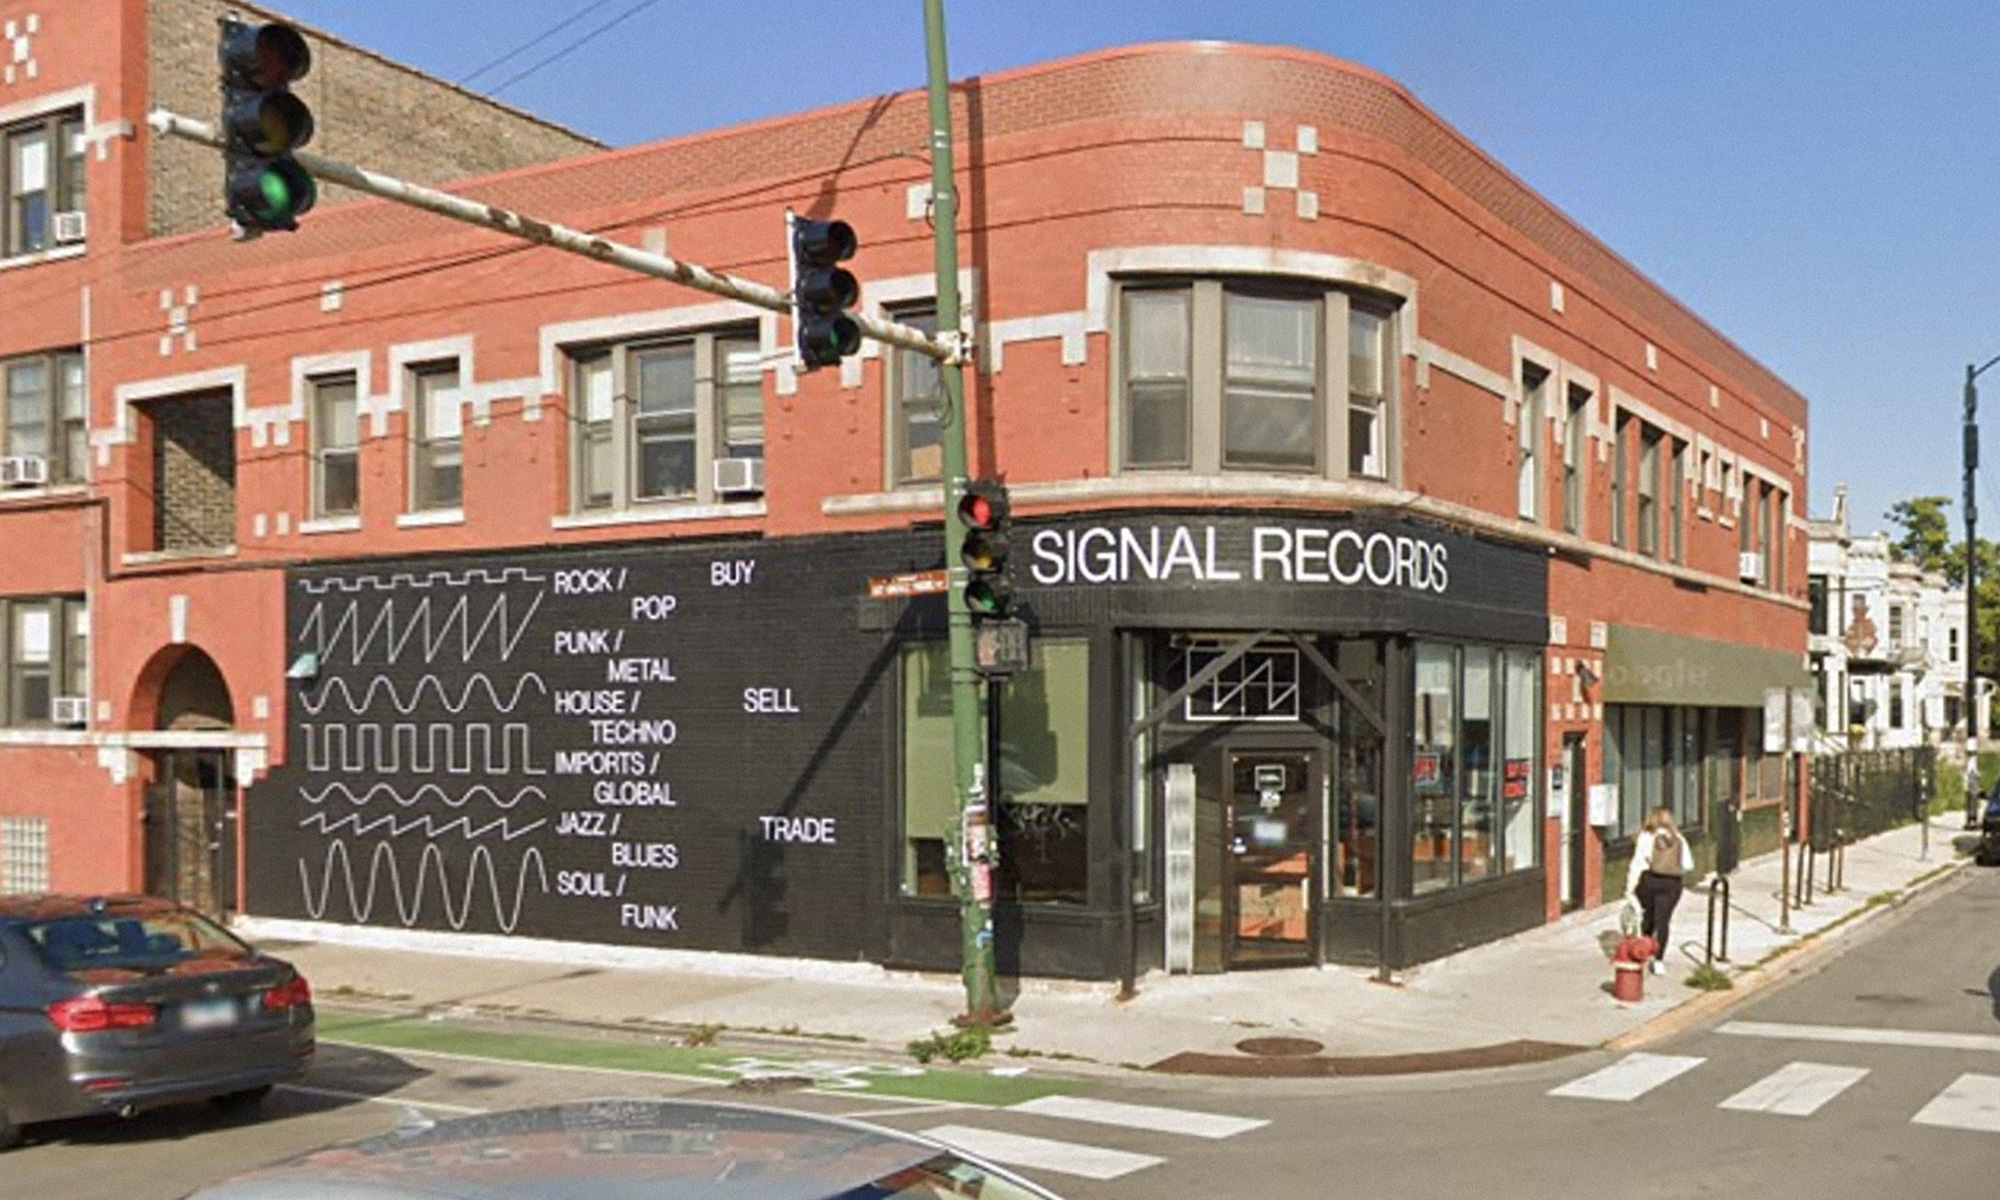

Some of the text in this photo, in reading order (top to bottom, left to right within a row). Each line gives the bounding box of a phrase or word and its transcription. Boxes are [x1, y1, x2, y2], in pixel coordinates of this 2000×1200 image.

[711, 559, 755, 586] BUY
[1031, 525, 1448, 594] SIGNAL RECORDS
[554, 568, 628, 594] ROCK /
[632, 595, 676, 620] POP
[554, 629, 624, 654] PUNK /
[608, 658, 676, 683] METAL
[555, 690, 642, 715] HOUSE /
[743, 687, 800, 713] SELL
[590, 719, 676, 745] TECHNO
[555, 751, 661, 776] IMPORTS /
[593, 780, 676, 806] GLOBAL
[555, 811, 622, 836] JAZZ /
[759, 815, 835, 843] TRADE
[612, 842, 678, 869] BLUES
[557, 870, 627, 897] SOUL /
[621, 903, 678, 930] FUNK
